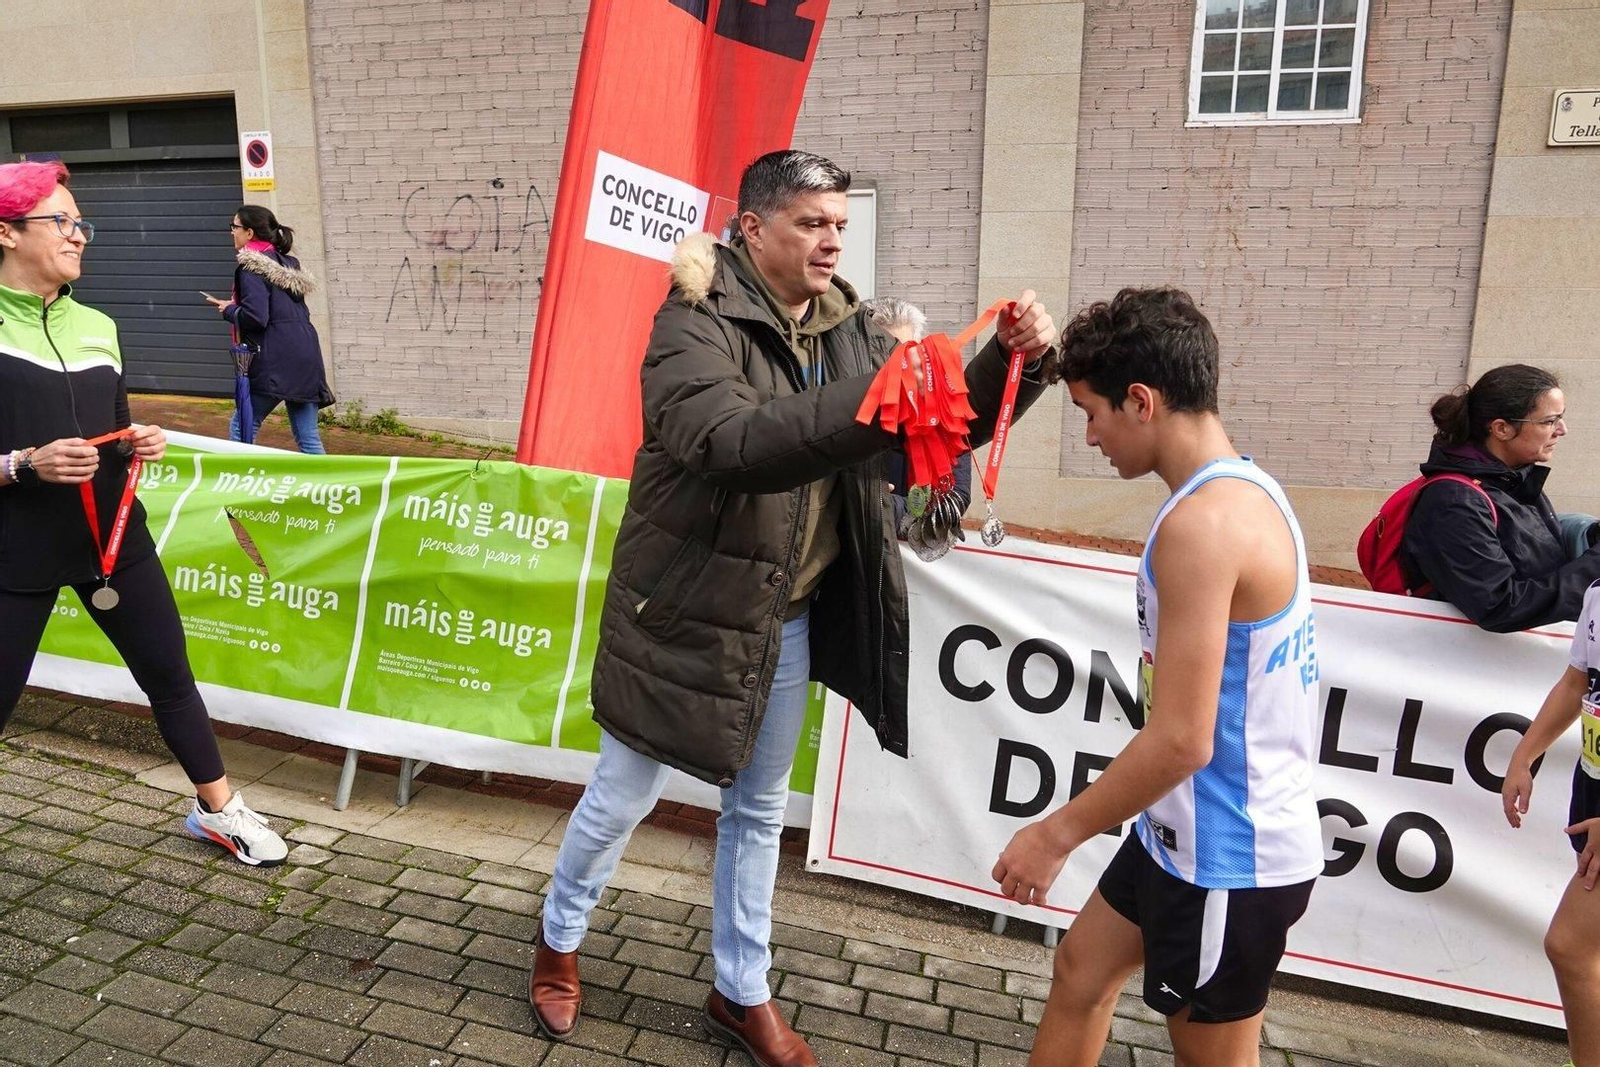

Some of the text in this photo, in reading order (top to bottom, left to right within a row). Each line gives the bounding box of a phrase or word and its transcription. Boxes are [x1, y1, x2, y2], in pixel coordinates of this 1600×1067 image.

[602, 174, 697, 225] CONCELLO
[609, 205, 685, 245] DE VIGO
[992, 431, 1004, 467] CONCELLO
[211, 467, 361, 514] máis que auga
[214, 506, 336, 535] pensado para ti
[403, 491, 569, 550] máis que auga
[417, 536, 540, 569] pensado para ti
[174, 562, 339, 619] máis que auga
[256, 627, 269, 637] Vigo
[384, 599, 552, 657] máis que auga
[466, 666, 480, 675] Vigo
[1316, 798, 1454, 893] GO
